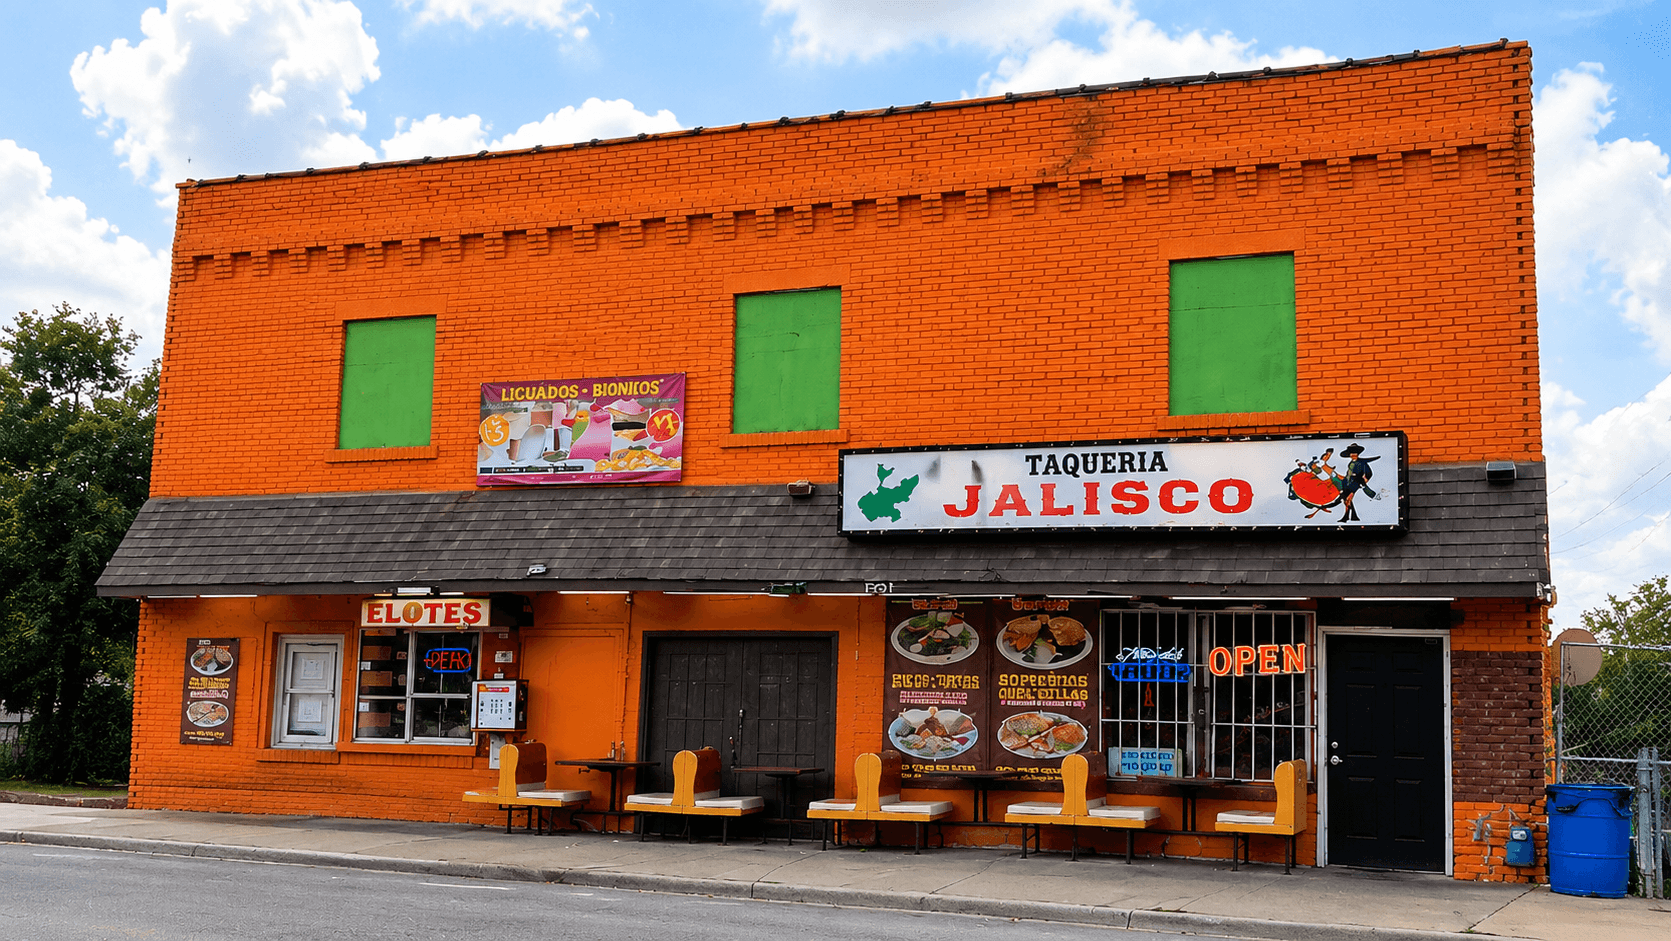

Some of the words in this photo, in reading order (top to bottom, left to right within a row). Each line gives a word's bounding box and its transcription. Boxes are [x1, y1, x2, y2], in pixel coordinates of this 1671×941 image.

[501, 385, 579, 402] LICUADOS
[1025, 451, 1168, 478] TAQUERIA
[943, 478, 1254, 518] JALISCO
[367, 601, 482, 624] ELOTES
[1209, 643, 1306, 676] OPEN
